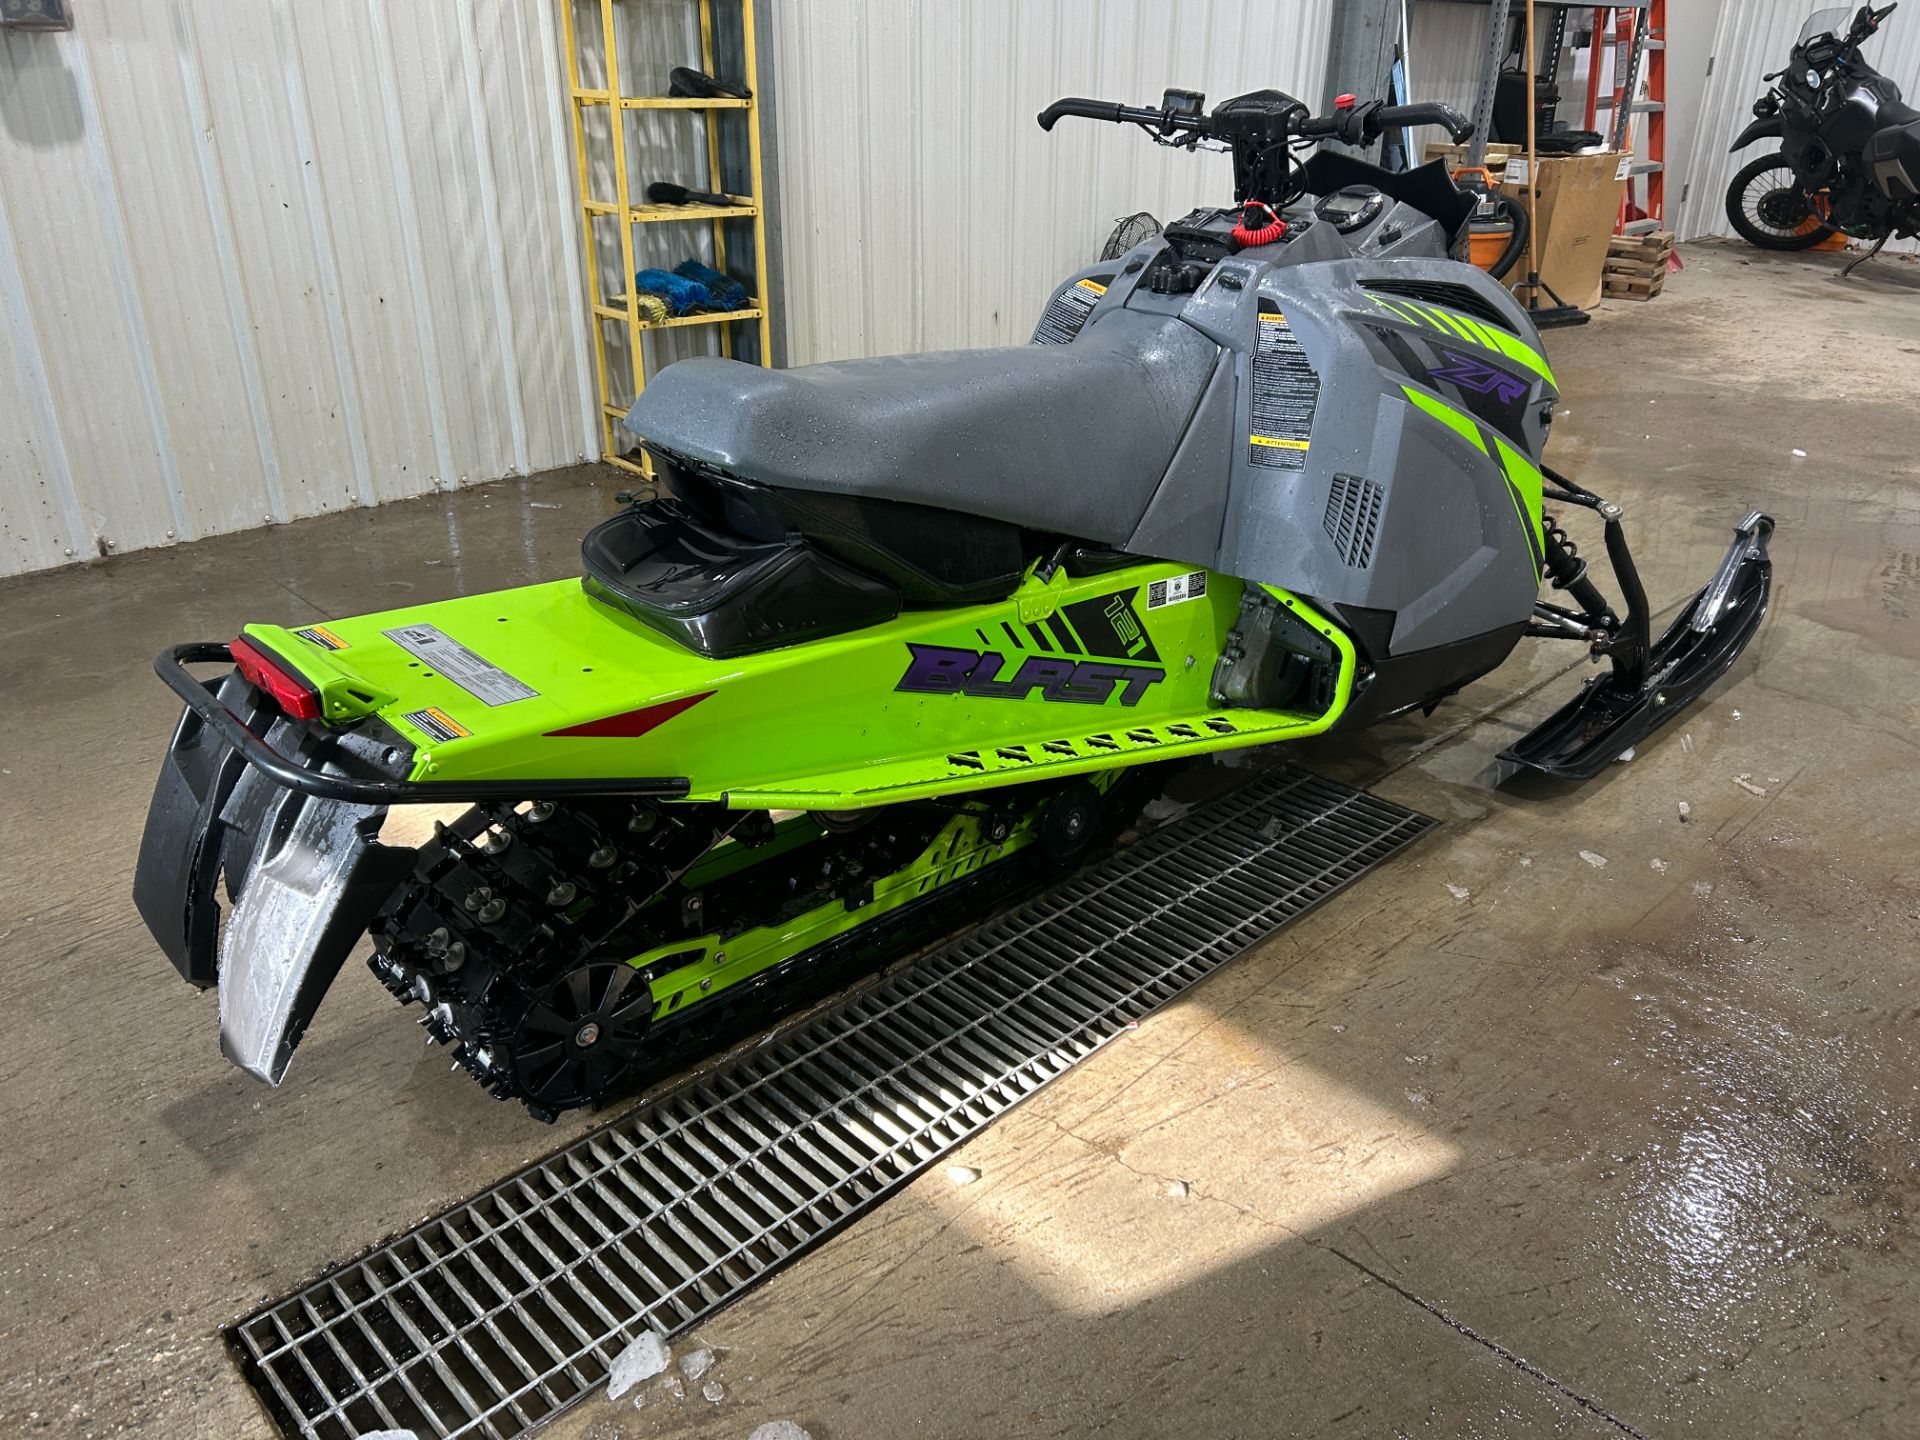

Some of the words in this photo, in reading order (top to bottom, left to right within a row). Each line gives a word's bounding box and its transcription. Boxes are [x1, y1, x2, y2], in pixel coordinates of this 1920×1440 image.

[1426, 350, 1529, 404] ZR
[1265, 440, 1301, 448] ATTENTION
[1103, 595, 1147, 657] 121
[894, 642, 1167, 707] BLAST
